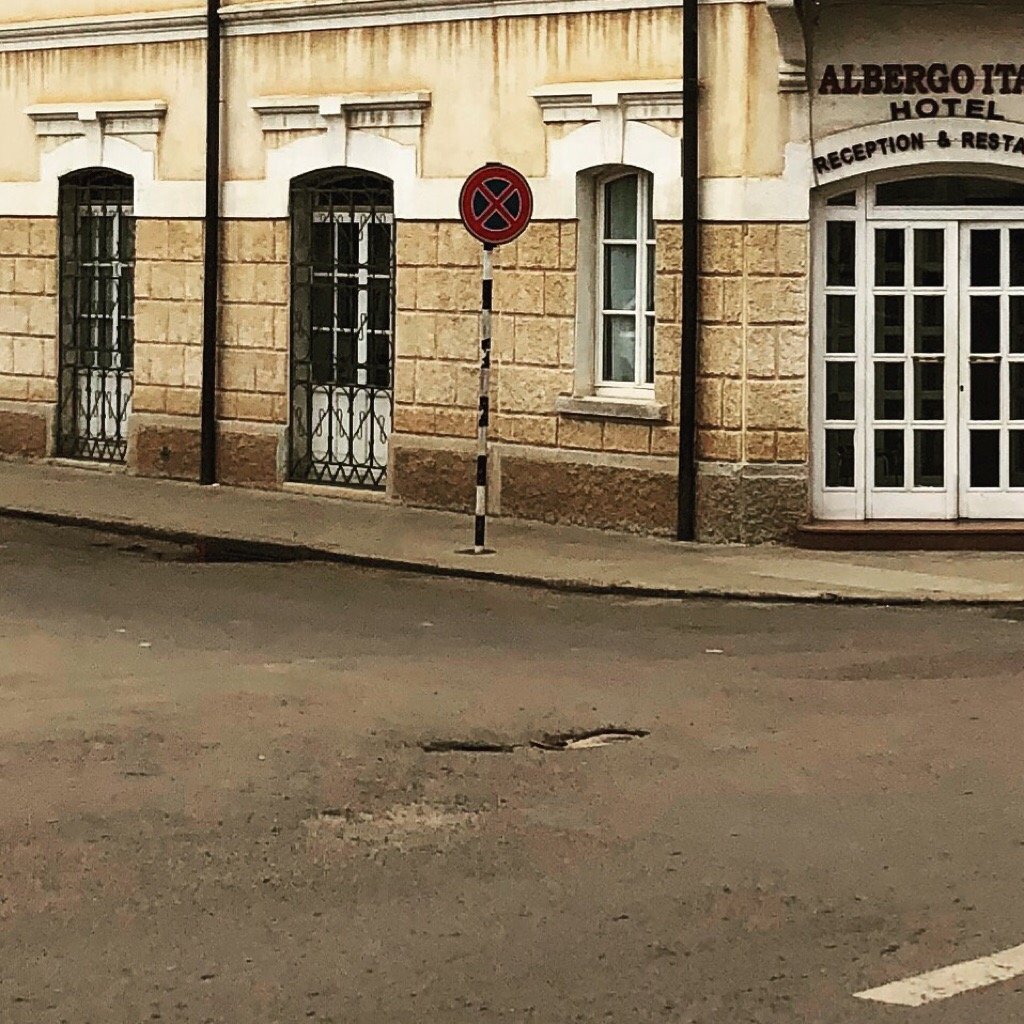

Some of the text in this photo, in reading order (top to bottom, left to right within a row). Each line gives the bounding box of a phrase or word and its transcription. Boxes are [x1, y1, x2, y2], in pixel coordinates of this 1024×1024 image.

[818, 63, 975, 95] ALBERGO
[890, 98, 1005, 121] HOTEL
[813, 132, 924, 175] RECEPTION
[936, 130, 951, 148] &
